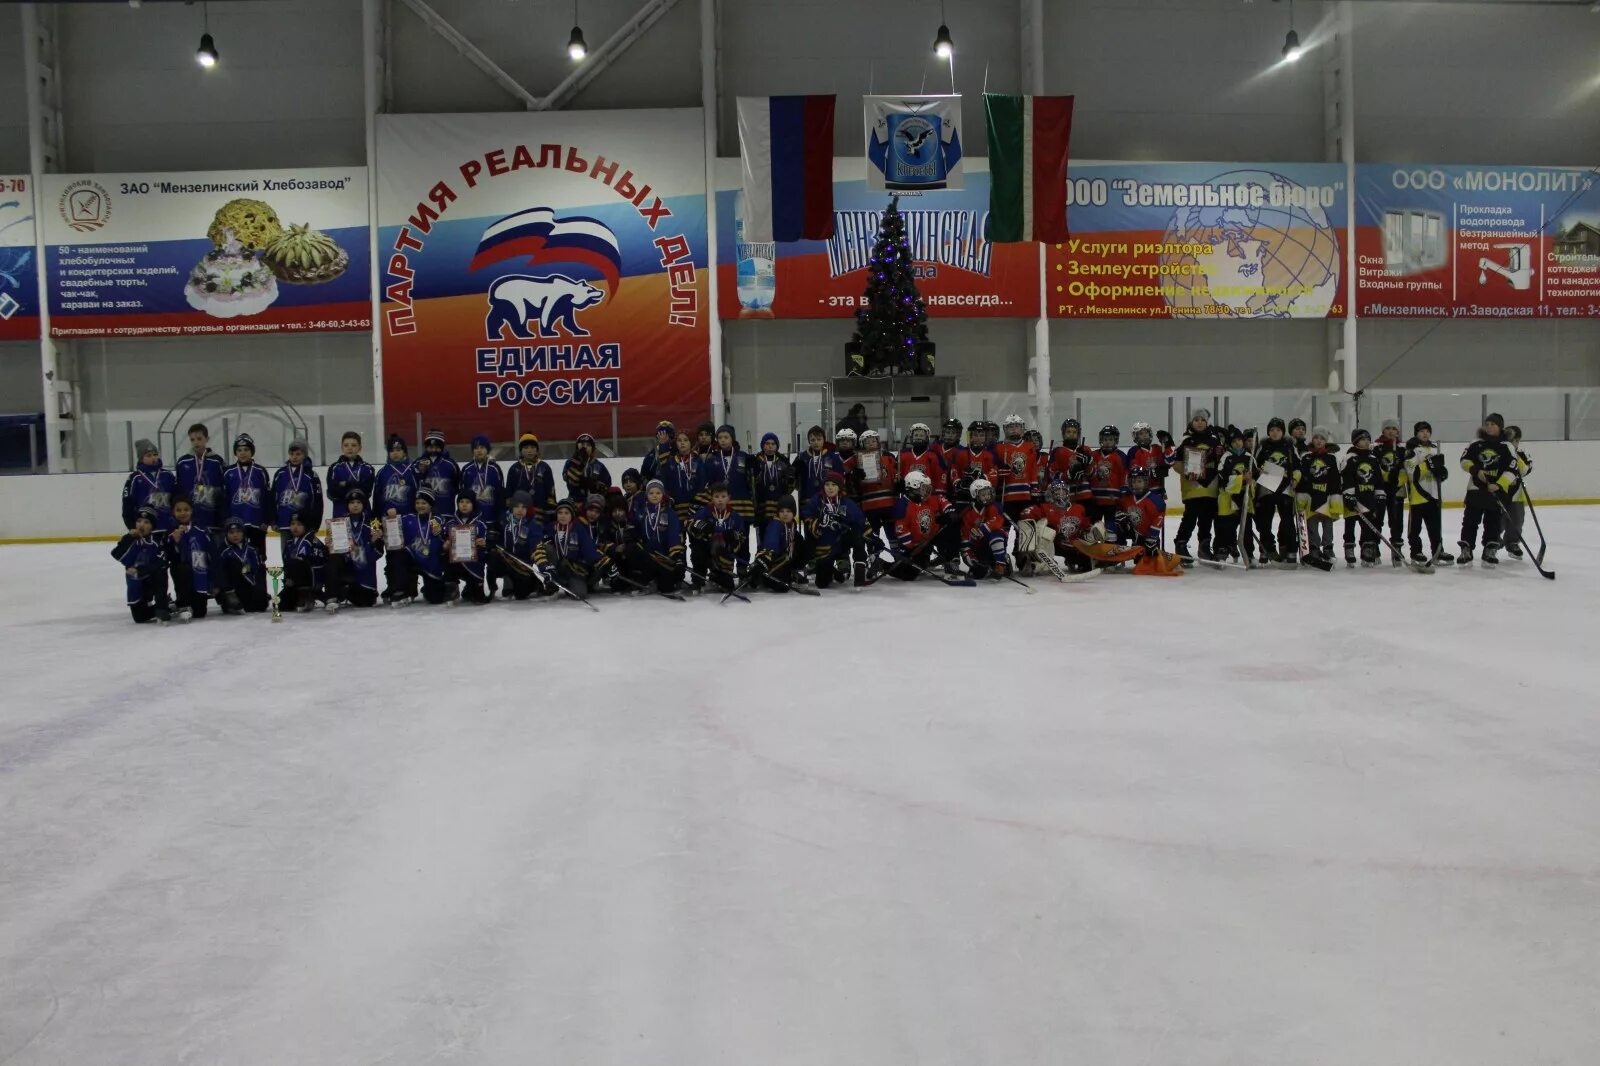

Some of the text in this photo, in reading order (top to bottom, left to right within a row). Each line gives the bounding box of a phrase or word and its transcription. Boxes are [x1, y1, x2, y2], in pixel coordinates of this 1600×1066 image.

[1392, 169, 1593, 192] ООО «МОНОЛИТ»
[120, 182, 149, 195] ЗАО
[1460, 204, 1512, 215] Прокладка
[1460, 218, 1526, 227] водопровода
[1460, 228, 1538, 239] безтраншейный
[386, 143, 698, 336] ПАРТИЯ РЕАЛЬНЫХ ДЕЛ!
[826, 210, 993, 278] МЕНЗИНСКАЯ
[58, 246, 70, 254] 50
[78, 245, 148, 254] наименований
[1068, 239, 1214, 258] Услуги риэлтора
[1460, 242, 1490, 251] метод
[59, 256, 136, 266] хлебобулочных
[1359, 255, 1384, 264] Окна
[68, 268, 135, 277] кондитерских
[136, 266, 180, 276] изделий,
[1359, 267, 1402, 278] Витражи
[1547, 264, 1597, 274] коттеджей
[60, 278, 148, 288] свадебные торты,
[1359, 279, 1442, 291] Входные группы
[60, 290, 99, 298] чак-чак,
[1068, 281, 1186, 300] Оформление
[828, 296, 855, 306] эта
[1059, 305, 1076, 315] РТ,
[52, 327, 105, 336] Приглашаем
[114, 326, 181, 335] сотрудничеству
[183, 325, 224, 333] торговые
[226, 324, 280, 332] организации
[476, 343, 620, 377] ЕДИНАЯ
[478, 378, 620, 407] РОССИЯ
